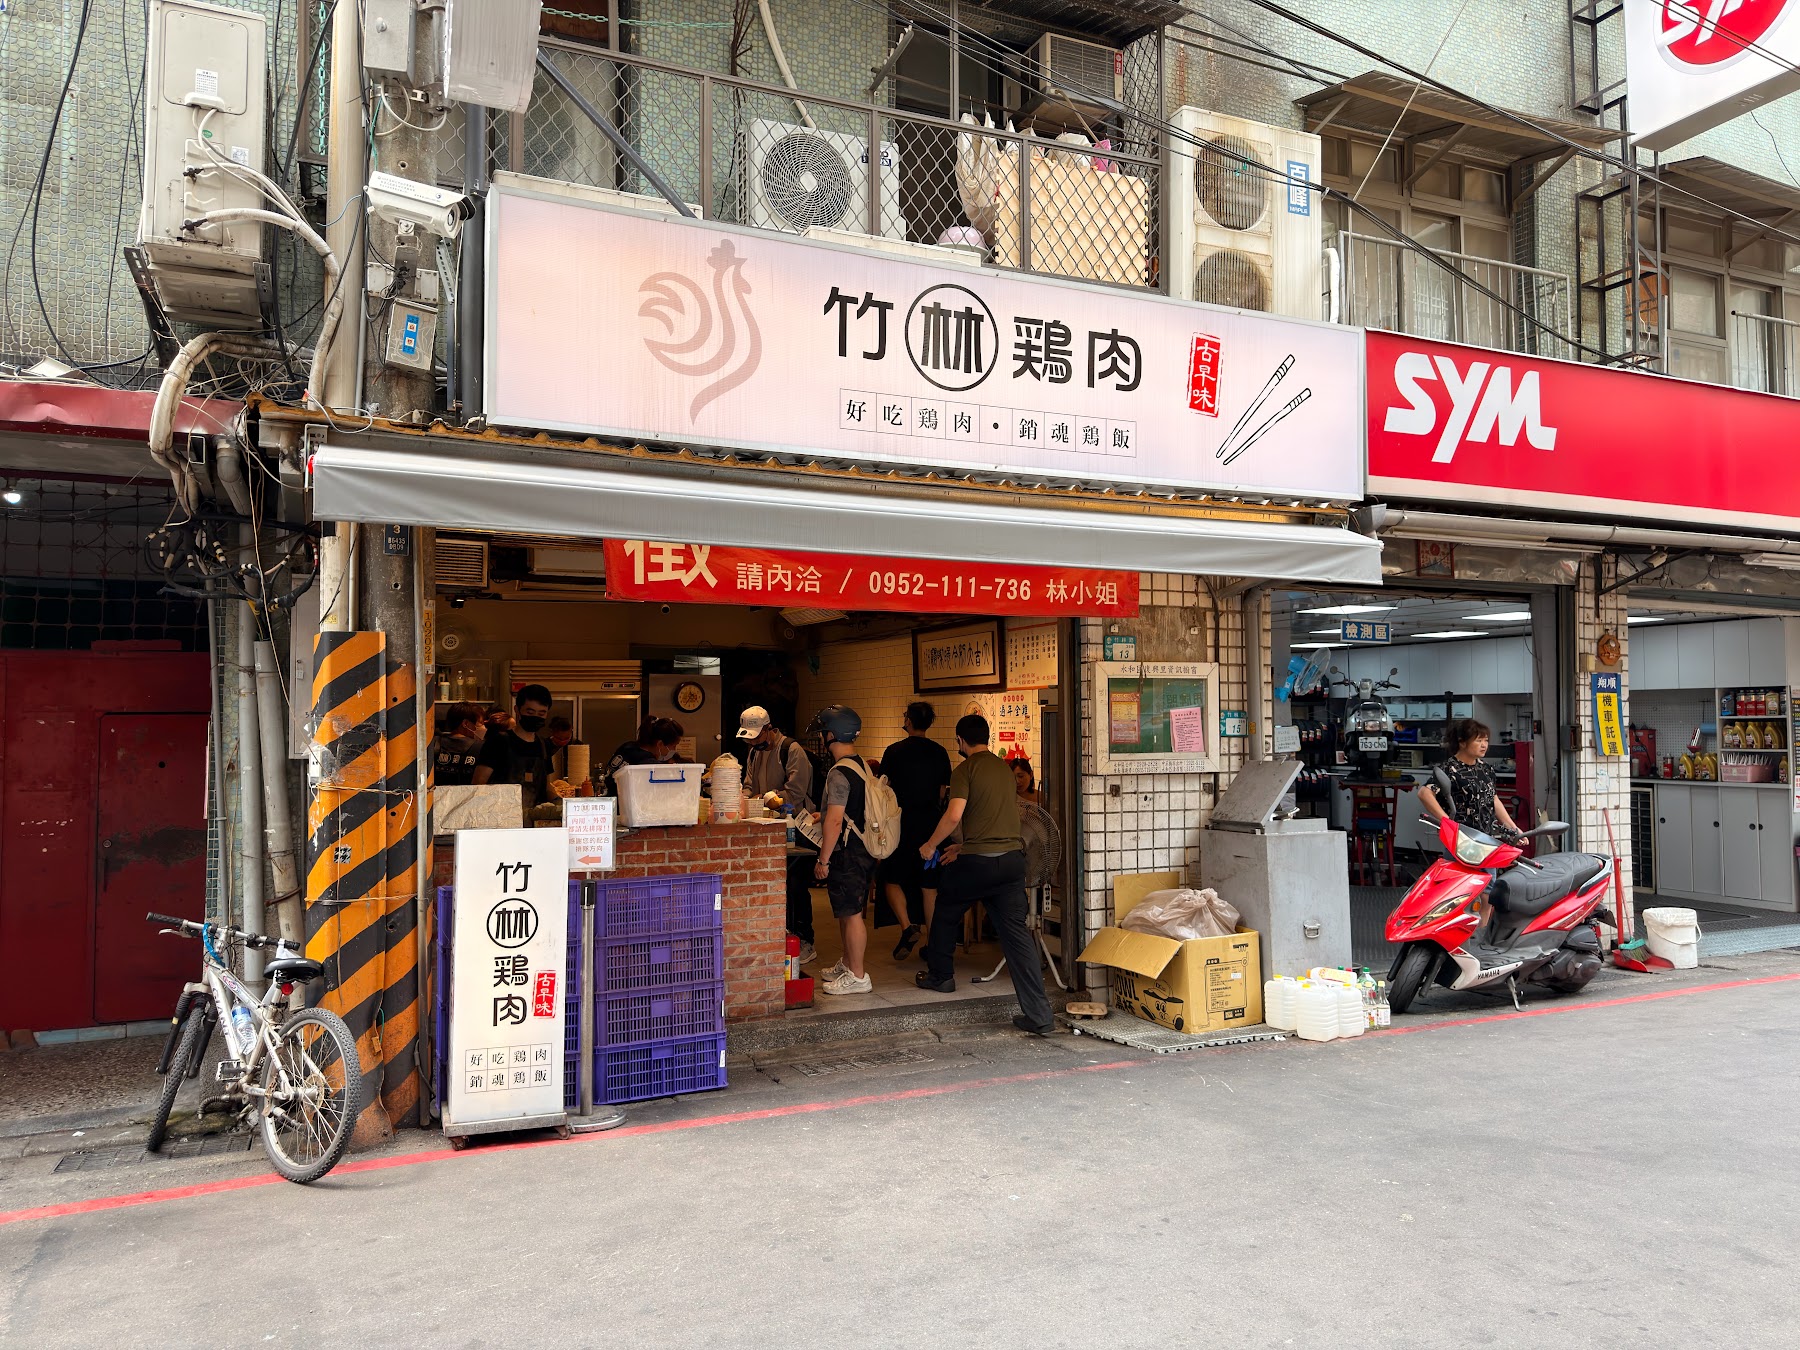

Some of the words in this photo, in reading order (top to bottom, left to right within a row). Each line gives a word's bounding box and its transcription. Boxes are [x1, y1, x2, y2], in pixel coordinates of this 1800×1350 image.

[1193, 339, 1216, 409] 古早味
[1384, 352, 1557, 463] SYM
[869, 571, 1031, 600] 0952-111-736
[1046, 578, 1119, 605] 林小姐
[424, 611, 433, 663] 102024
[1346, 622, 1387, 639] 檢測區
[1119, 650, 1129, 659] 13
[1597, 676, 1616, 689] 翔順
[1232, 724, 1241, 733] 15
[1602, 693, 1619, 754] 機車託運
[1477, 969, 1500, 980] YAMAHA
[535, 974, 555, 1016] 古早味
